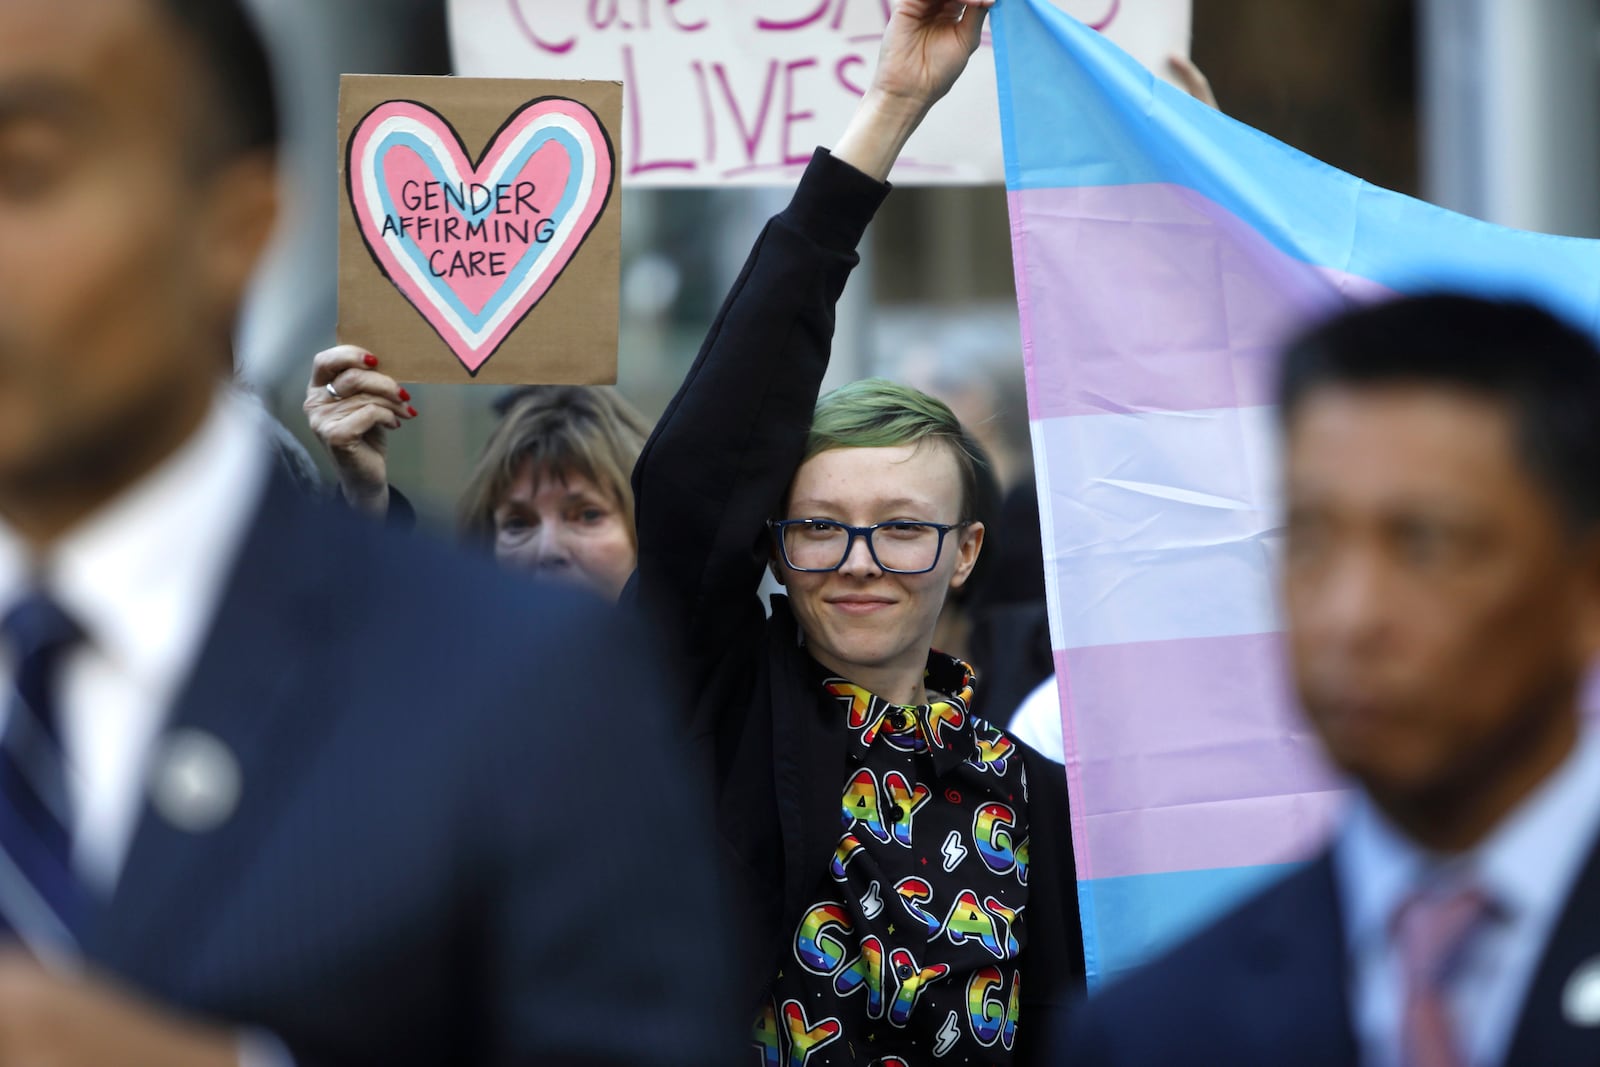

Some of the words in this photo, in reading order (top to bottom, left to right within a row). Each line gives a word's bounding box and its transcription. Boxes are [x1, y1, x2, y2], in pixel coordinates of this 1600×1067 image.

[402, 180, 540, 215] GENDER
[382, 214, 555, 243] AFFIRMING
[429, 250, 506, 278] CARE
[793, 901, 950, 1028] GAY
